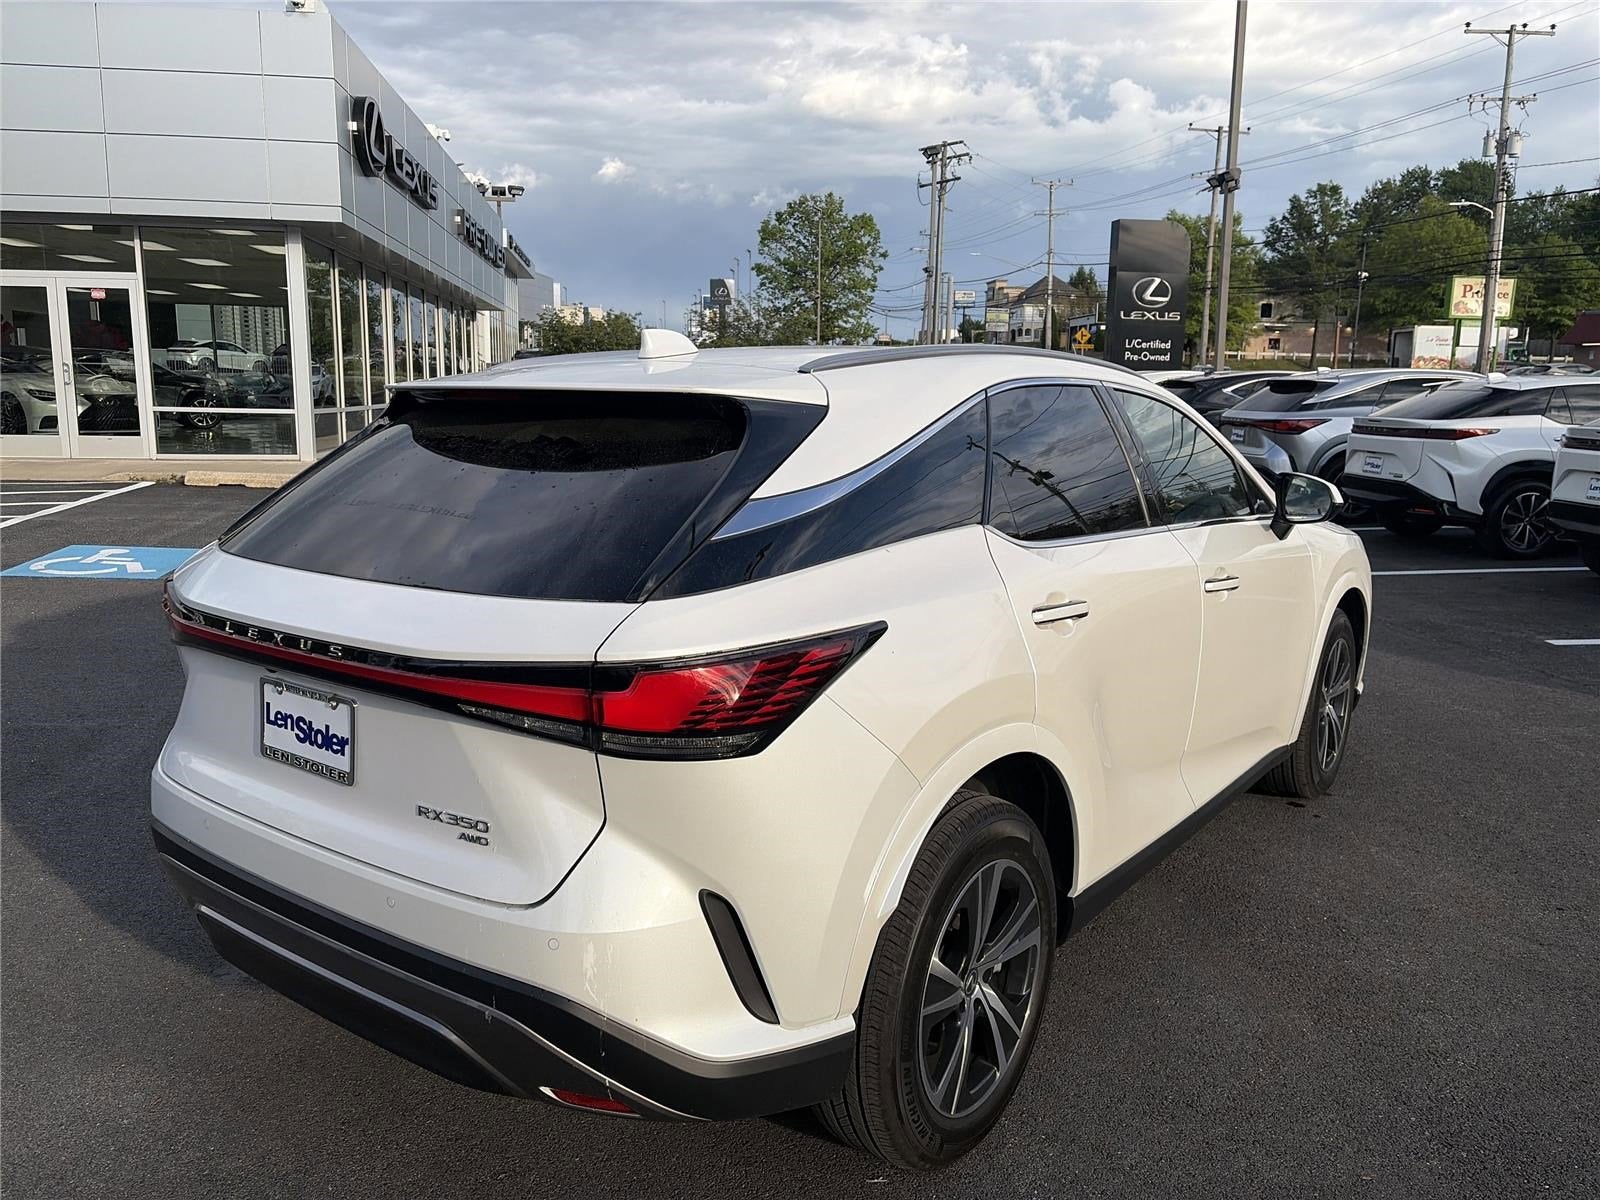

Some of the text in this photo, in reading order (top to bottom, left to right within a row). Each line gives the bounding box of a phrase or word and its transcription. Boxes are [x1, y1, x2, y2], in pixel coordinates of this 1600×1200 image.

[385, 134, 438, 210] LEXUS
[1120, 310, 1181, 321] LEXUS
[1124, 351, 1171, 362] Pre-Owned
[1125, 338, 1172, 350] L/Certified
[225, 620, 343, 657] LEXUS
[264, 746, 348, 784] LEN STOLER
[415, 804, 491, 833] RX350
[457, 832, 490, 847] AWD
[902, 1066, 928, 1138] MICHELIN
